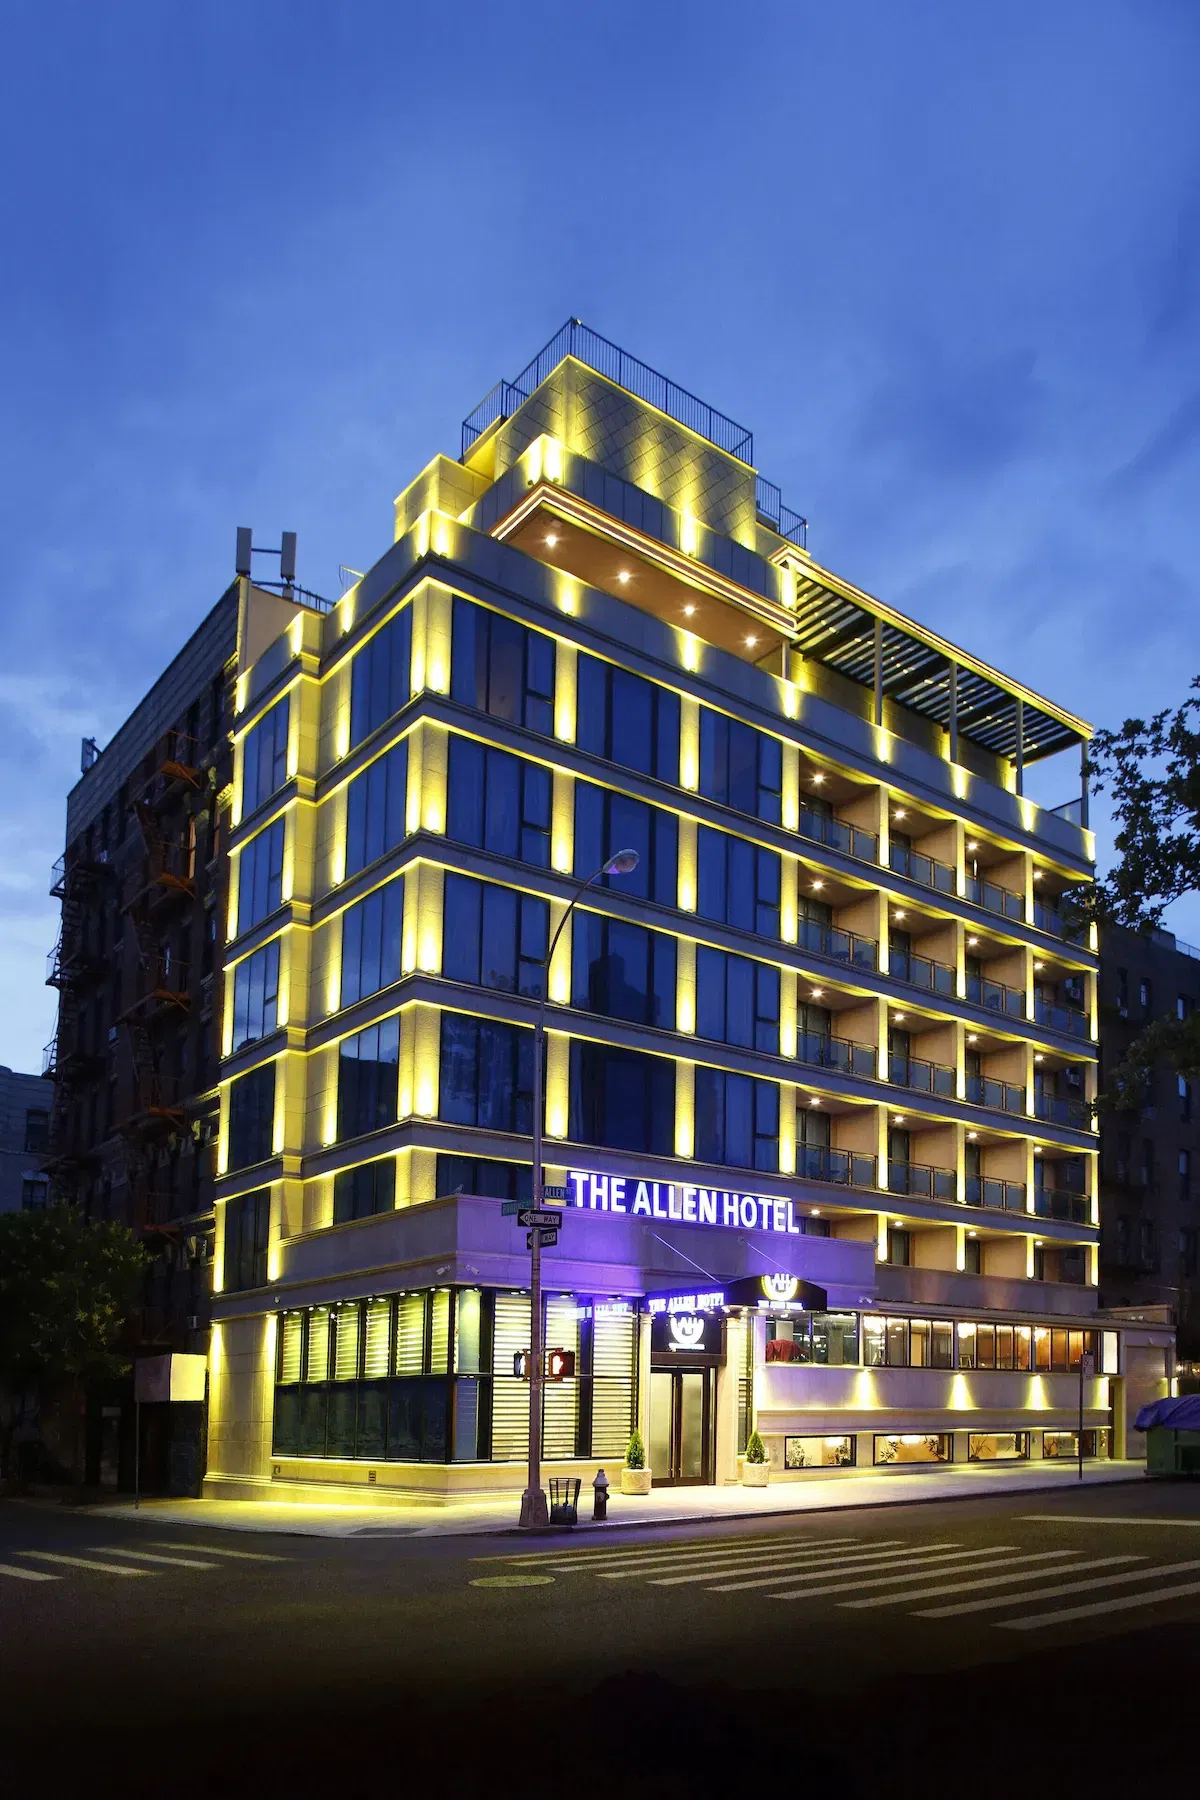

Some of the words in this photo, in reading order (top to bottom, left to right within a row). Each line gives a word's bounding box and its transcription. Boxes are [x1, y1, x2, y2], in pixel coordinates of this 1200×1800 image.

[544, 1187, 565, 1199] ALLEN
[570, 1171, 626, 1213] THE
[632, 1181, 718, 1224] ALLEN
[723, 1193, 800, 1234] HOTEL
[524, 1215, 538, 1223] ONE
[543, 1216, 557, 1224] WAY
